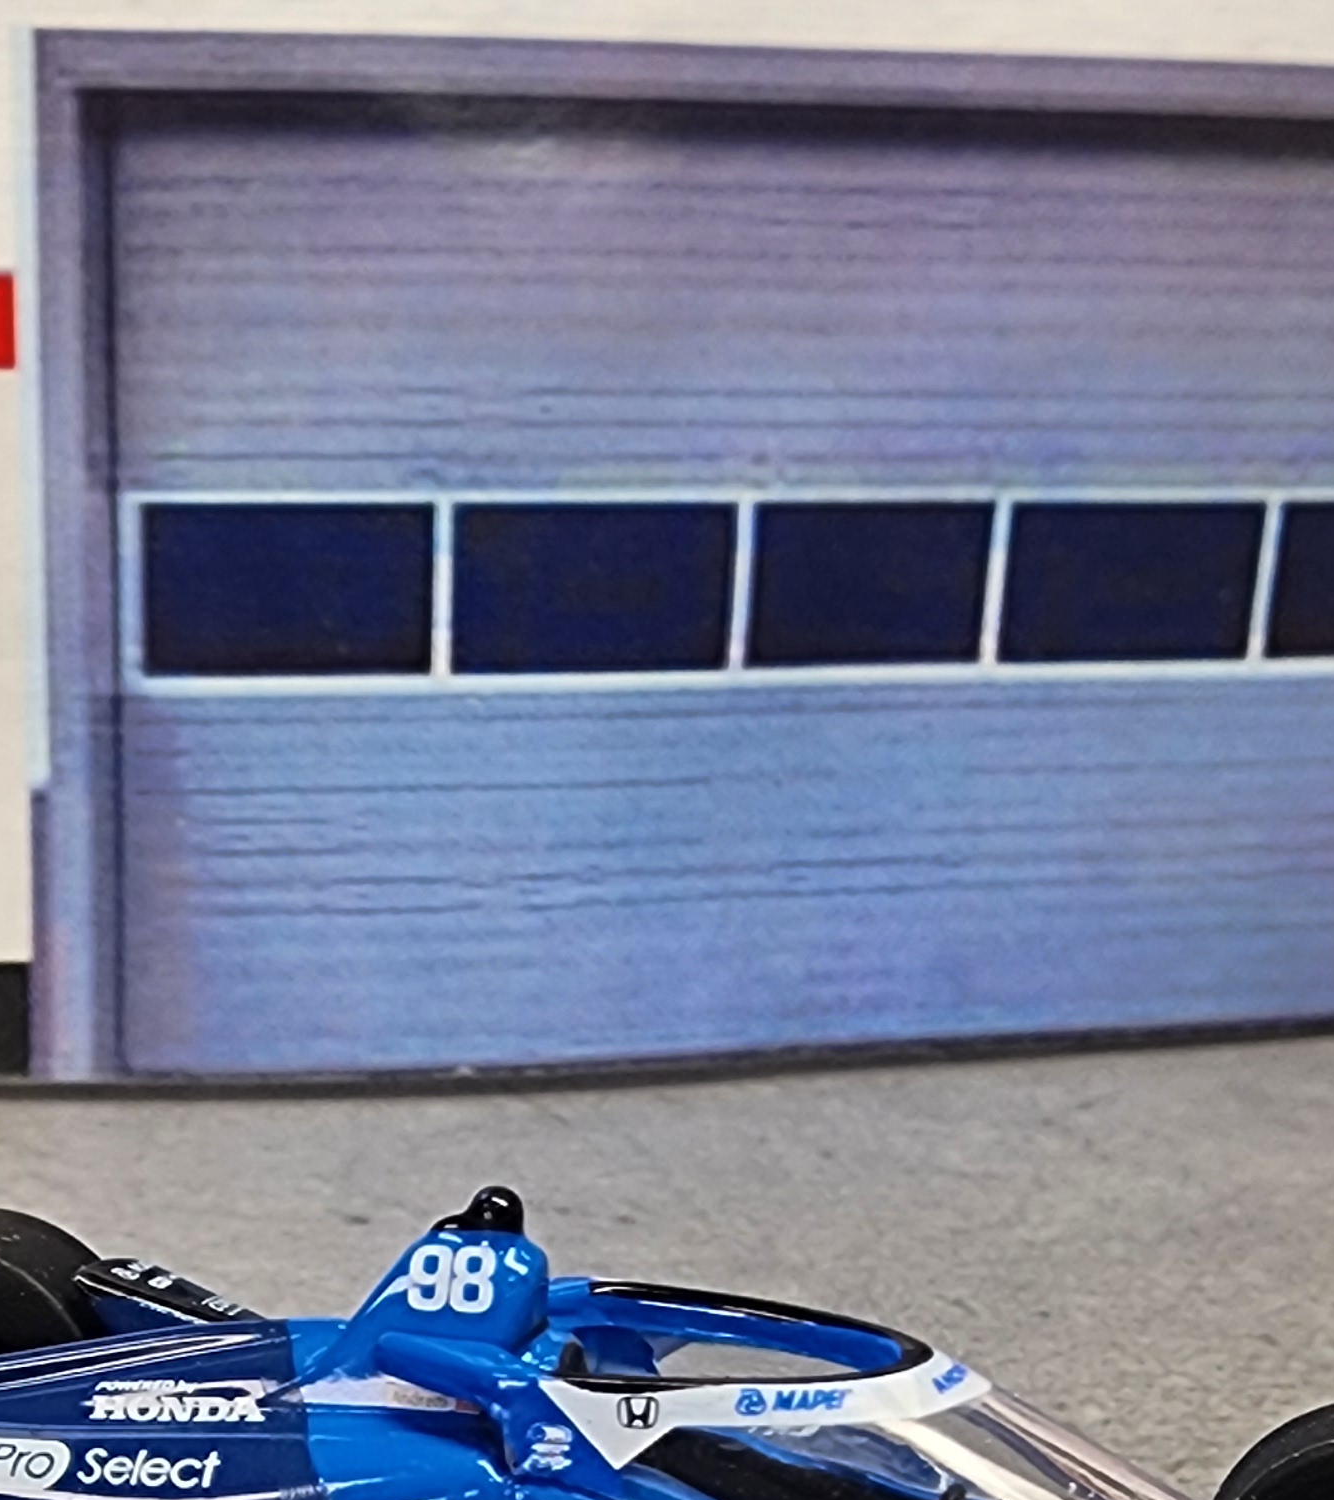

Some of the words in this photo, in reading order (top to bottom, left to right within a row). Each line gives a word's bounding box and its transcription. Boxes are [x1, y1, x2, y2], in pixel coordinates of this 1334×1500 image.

[408, 1244, 497, 1313] 98
[89, 1395, 266, 1422] HONDA
[76, 1447, 221, 1489] Select
